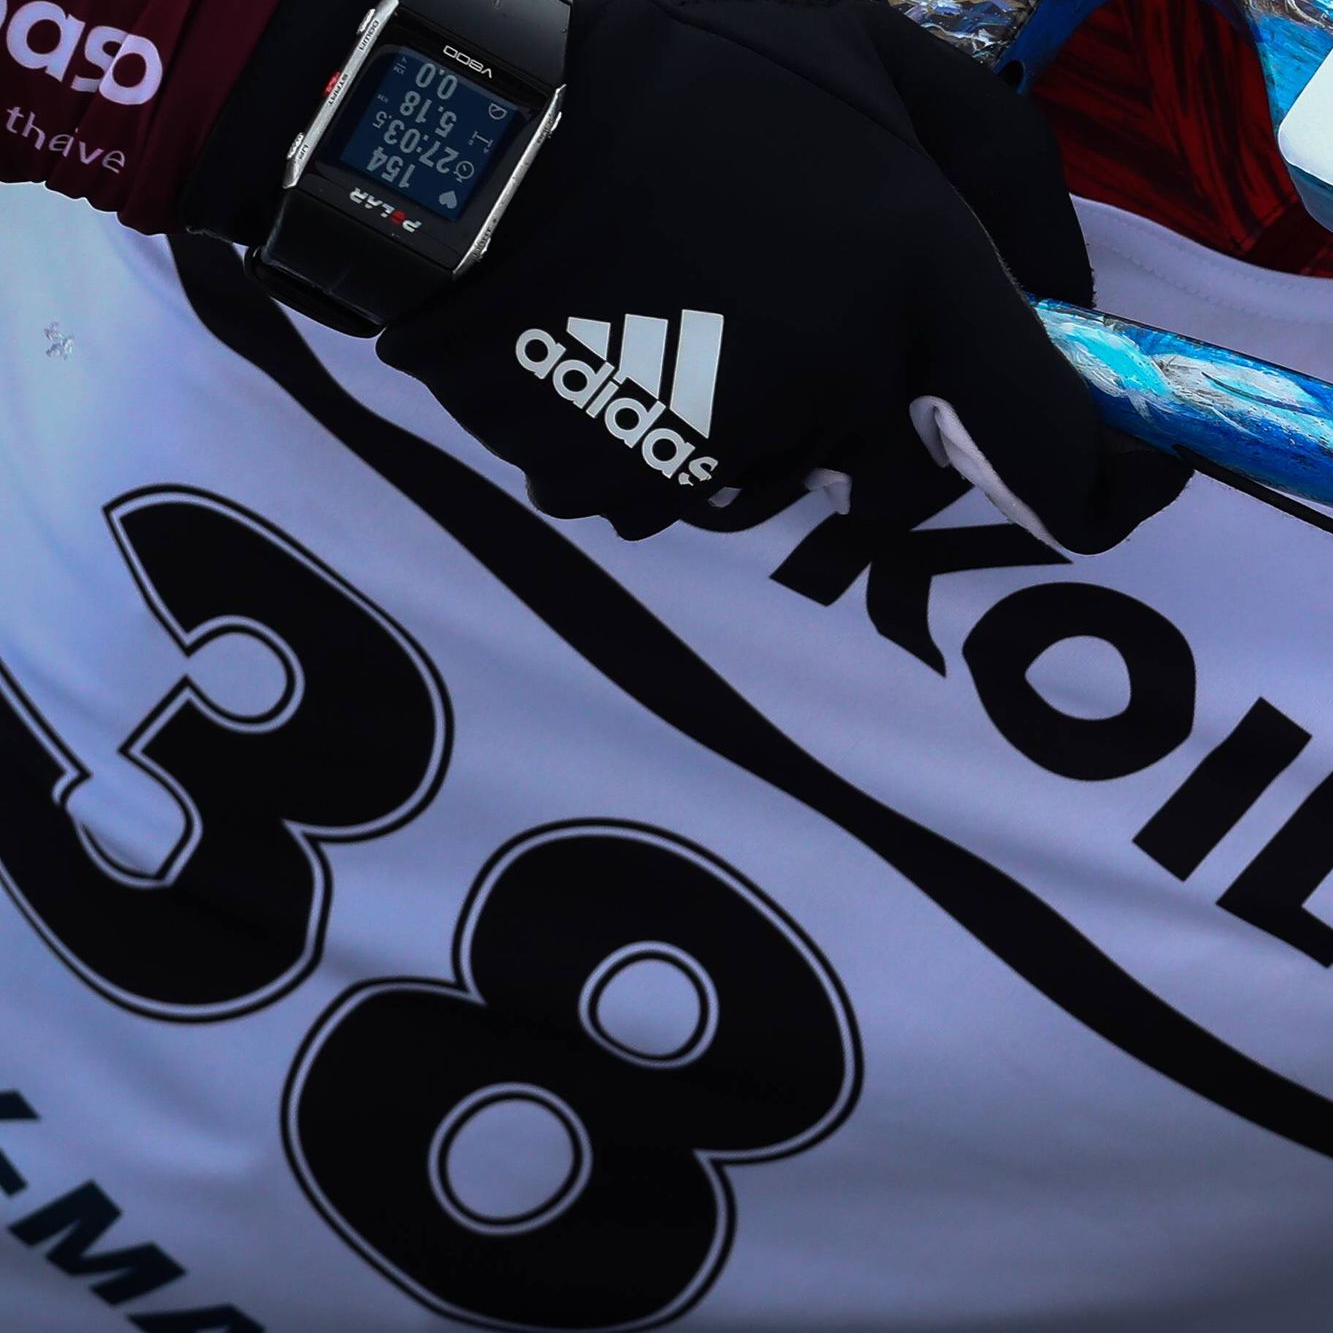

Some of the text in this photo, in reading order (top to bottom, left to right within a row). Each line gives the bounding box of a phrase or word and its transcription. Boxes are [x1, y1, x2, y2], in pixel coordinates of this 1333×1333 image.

[415, 62, 458, 100] 0.0
[443, 45, 493, 79] V800
[399, 90, 457, 139] 5.18
[366, 145, 418, 189] 154
[349, 186, 423, 233] POLAR
[515, 328, 719, 487] adidas
[0, 484, 866, 1333] 38
